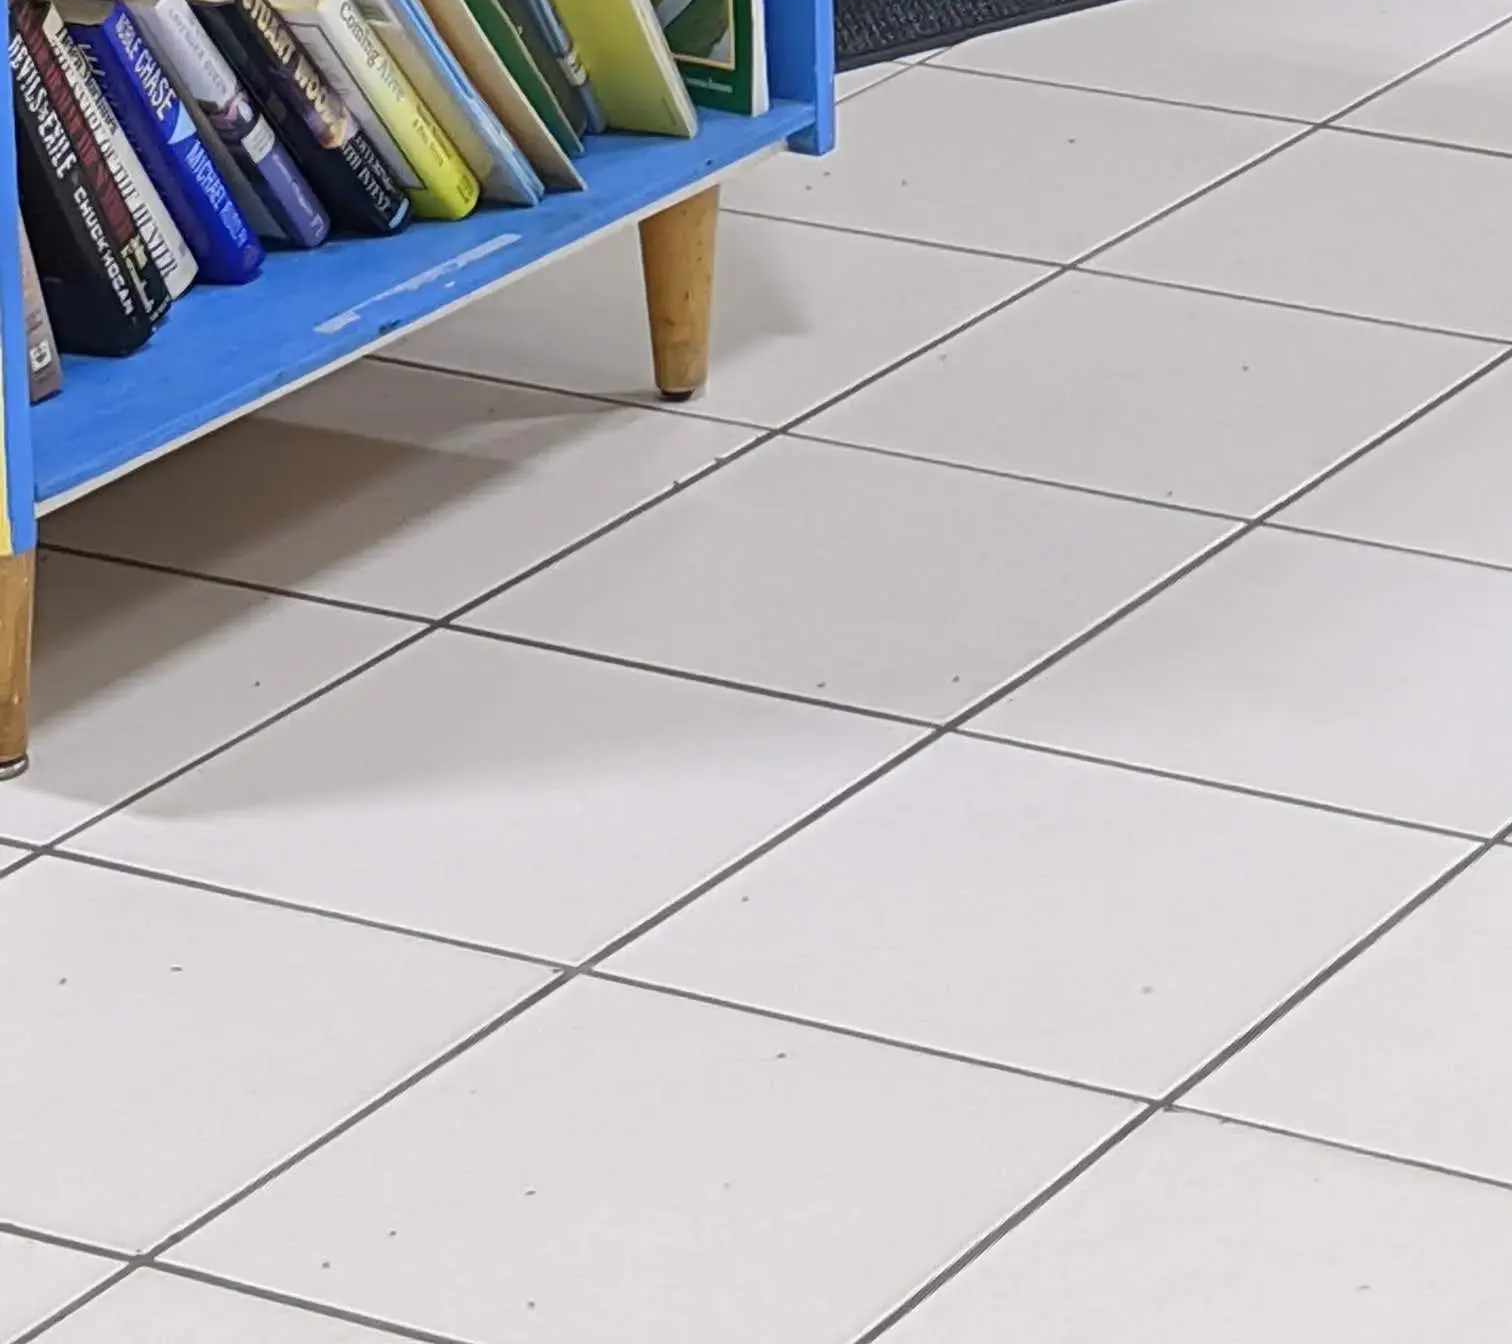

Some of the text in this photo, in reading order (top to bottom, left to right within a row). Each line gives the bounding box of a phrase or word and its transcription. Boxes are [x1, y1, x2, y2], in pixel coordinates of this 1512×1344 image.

[340, 0, 381, 69] Coming
[8, 33, 48, 112] DEVILS
[38, 110, 78, 180] EXILE
[73, 186, 109, 253] CHUCK
[102, 249, 135, 316] HOGAN
[134, 49, 177, 122] CHASE
[185, 139, 227, 213] MICHAEL
